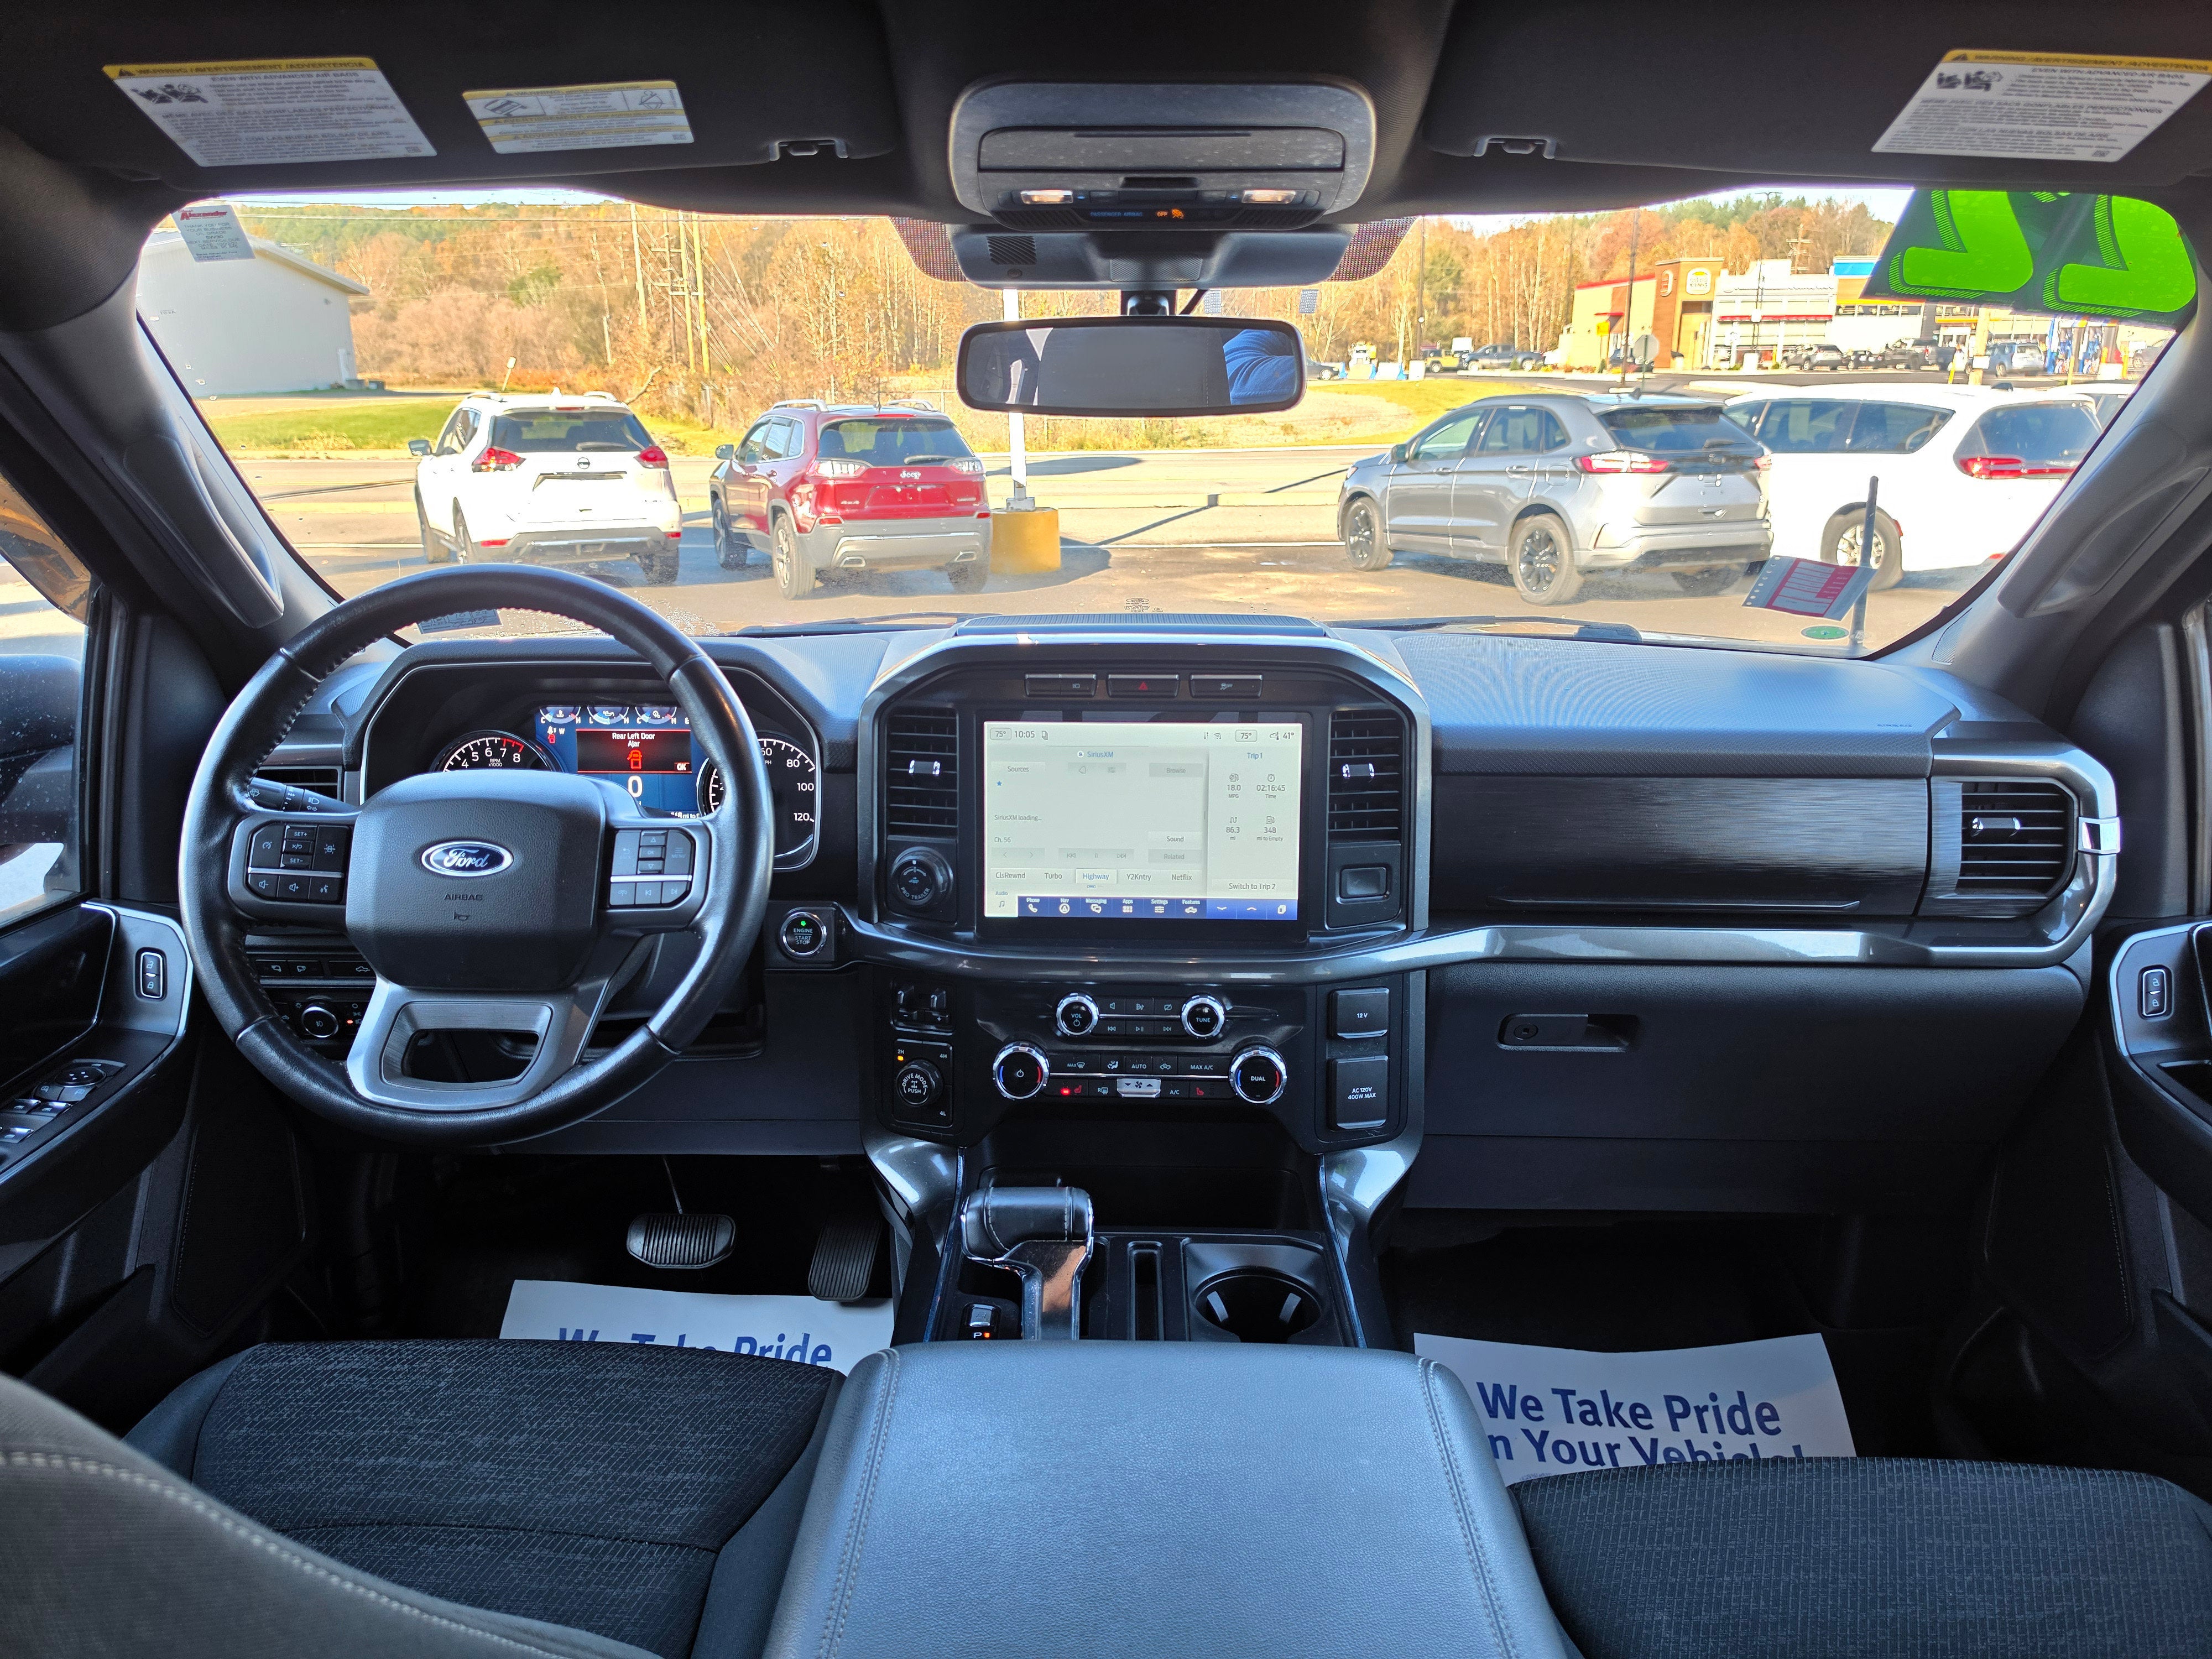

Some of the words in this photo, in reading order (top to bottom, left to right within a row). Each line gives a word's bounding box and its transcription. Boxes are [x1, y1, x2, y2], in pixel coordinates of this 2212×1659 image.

[472, 752, 479, 761] 5
[484, 747, 493, 757] 6
[499, 748, 507, 758] 7
[513, 753, 521, 763] 8
[461, 759, 469, 768] 4
[786, 759, 800, 768] 80
[628, 775, 643, 798] 0
[797, 782, 815, 791] 100
[794, 812, 810, 821] 120
[443, 848, 491, 868] Ford
[1083, 873, 1109, 881] Highway
[1126, 873, 1151, 881] Y2Kntry
[900, 886, 910, 898] PRO
[911, 888, 930, 900] TRAILER
[902, 1073, 914, 1087] DRIVE
[915, 1073, 928, 1088] MODE
[1476, 1381, 1544, 1423] We
[1551, 1387, 1653, 1430] Take
[1664, 1390, 1781, 1436] Pride
[1488, 1434, 1514, 1460] n
[1520, 1428, 1621, 1467] Your
